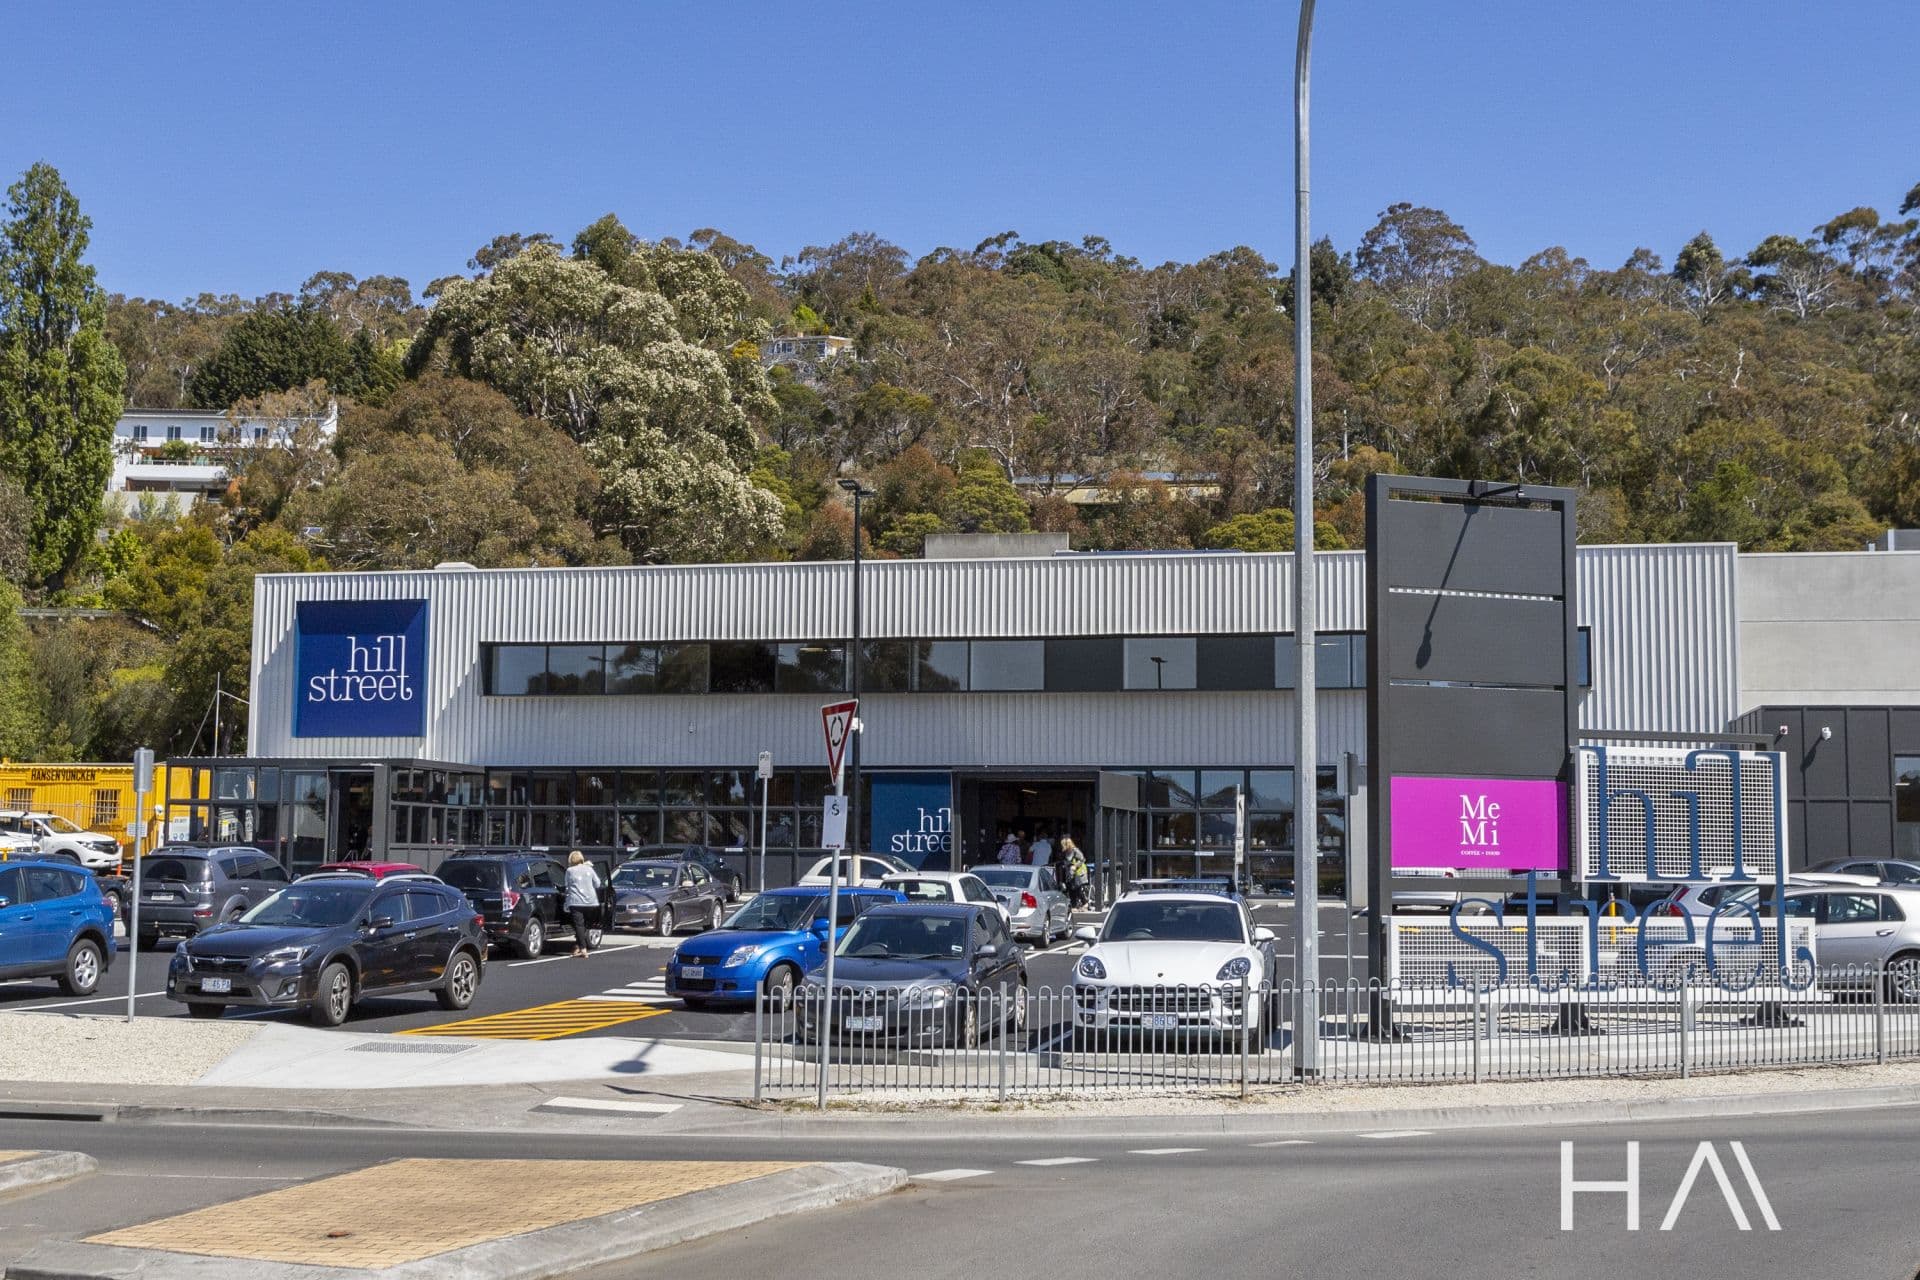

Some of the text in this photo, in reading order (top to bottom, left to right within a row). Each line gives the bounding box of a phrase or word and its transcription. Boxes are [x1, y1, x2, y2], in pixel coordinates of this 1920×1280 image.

[346, 635, 406, 673] hill
[308, 668, 413, 702] street
[1459, 794, 1501, 819] Me
[1579, 745, 1785, 881] hill
[1460, 820, 1500, 846] Mi
[1448, 868, 1816, 994] street
